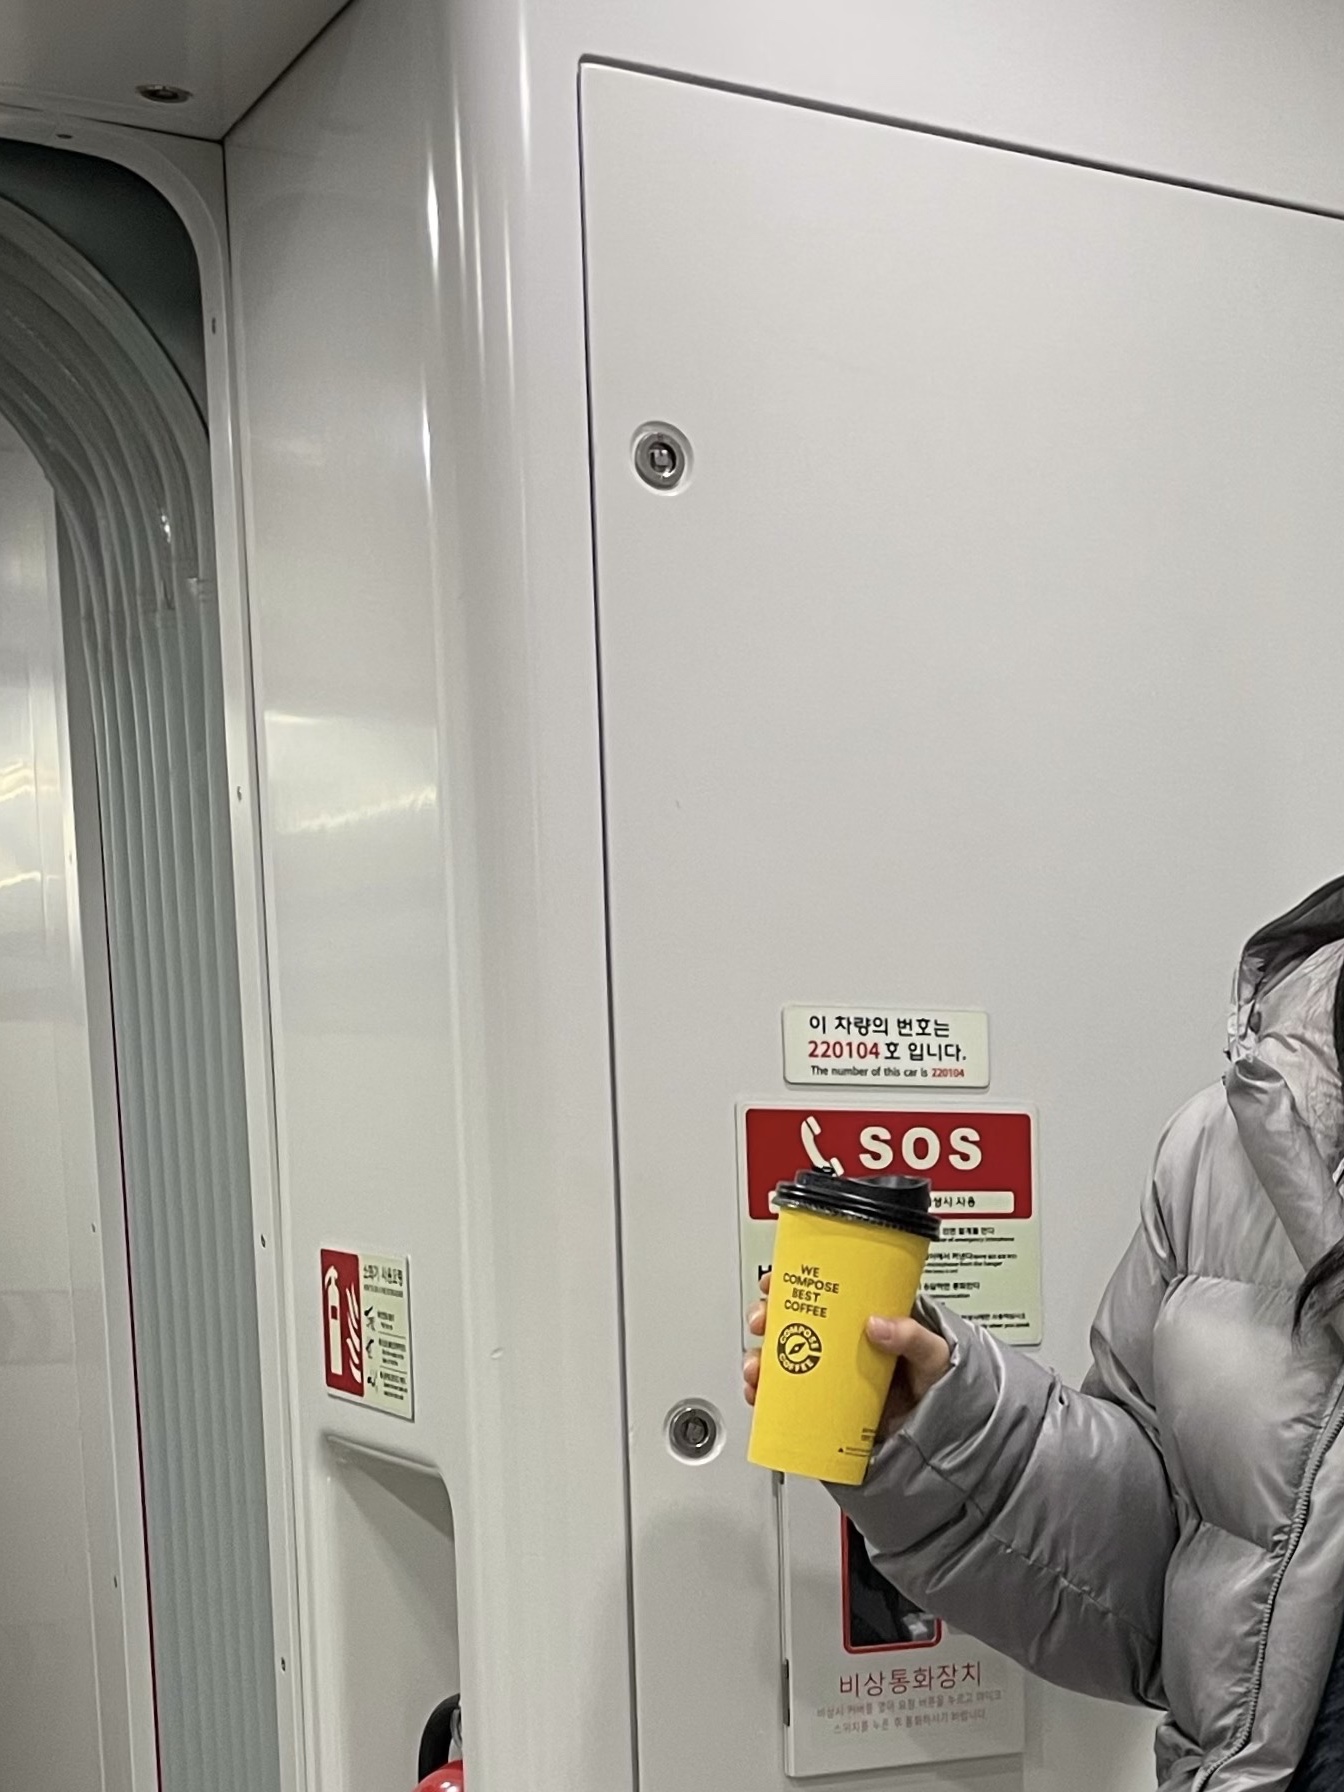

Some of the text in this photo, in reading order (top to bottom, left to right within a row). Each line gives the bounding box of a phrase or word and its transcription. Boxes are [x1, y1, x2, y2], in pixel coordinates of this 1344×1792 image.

[809, 1015, 951, 1038] 이 차량의 번호는
[908, 1043, 967, 1061] 입니다.
[811, 1065, 965, 1078] The number of this car is 220104
[859, 1126, 982, 1170] SOS
[801, 1264, 820, 1278] WE
[783, 1272, 840, 1294] COMPOSE
[792, 1287, 821, 1303] BEST
[784, 1299, 828, 1318] COFFEE
[780, 1326, 820, 1350] COMPOSE
[779, 1353, 815, 1373] COFFEE
[840, 1661, 981, 1698] 비상통화장치
